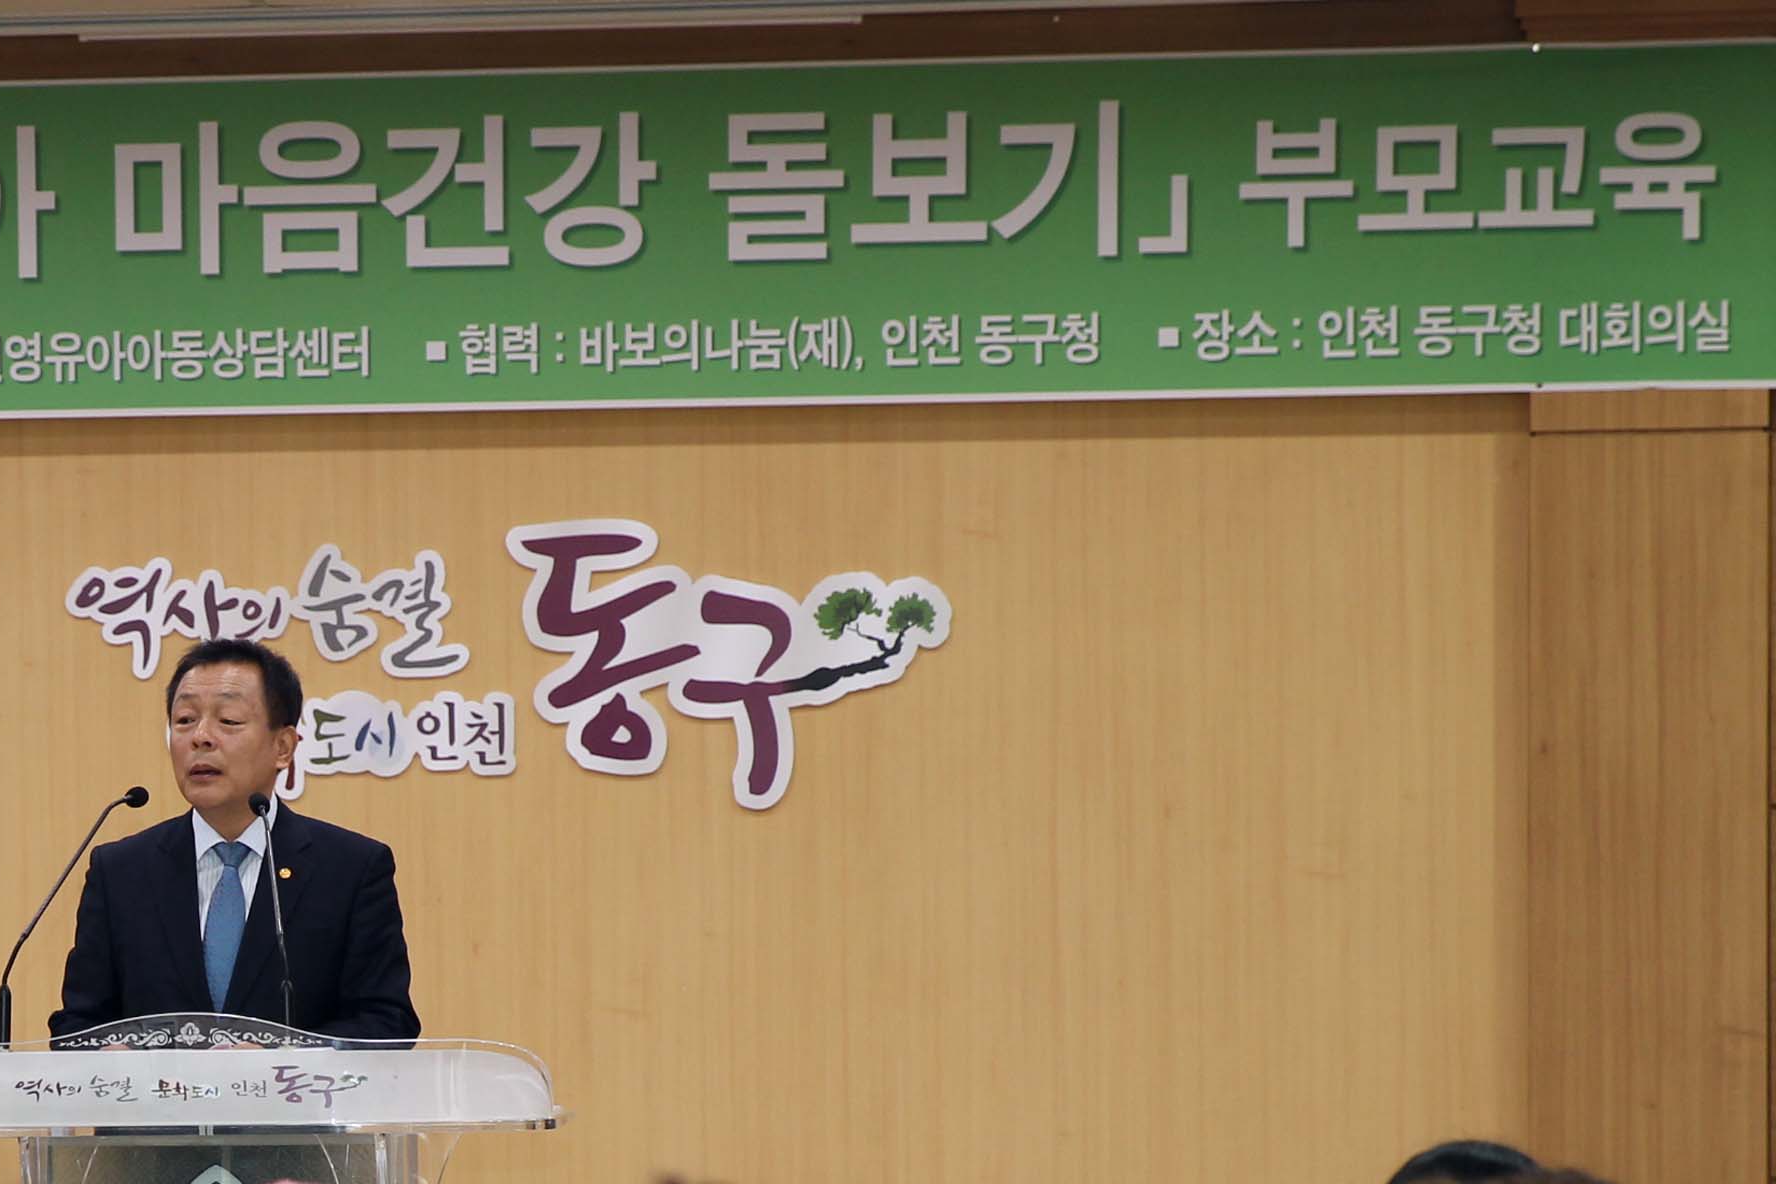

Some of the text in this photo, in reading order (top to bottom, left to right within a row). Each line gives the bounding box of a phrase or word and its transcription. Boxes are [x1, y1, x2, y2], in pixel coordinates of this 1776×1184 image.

[114, 111, 657, 275] 마음건강
[1238, 111, 1717, 248] 부모교육
[458, 321, 540, 374] 협력
[579, 314, 864, 374] 바보의나눔(재),
[881, 315, 961, 366] 인천
[974, 312, 1102, 365] 동구청
[1192, 309, 1279, 361] 장소
[1317, 305, 1400, 358] 인천
[1413, 302, 1542, 356] 동구청
[1558, 300, 1731, 353] 대회의실
[75, 554, 460, 669] 역사의 숨결
[521, 534, 796, 795] 동구
[417, 701, 507, 766] 인천
[15, 1065, 338, 1108] 역사의 숨결 문화도시 인천 동구
